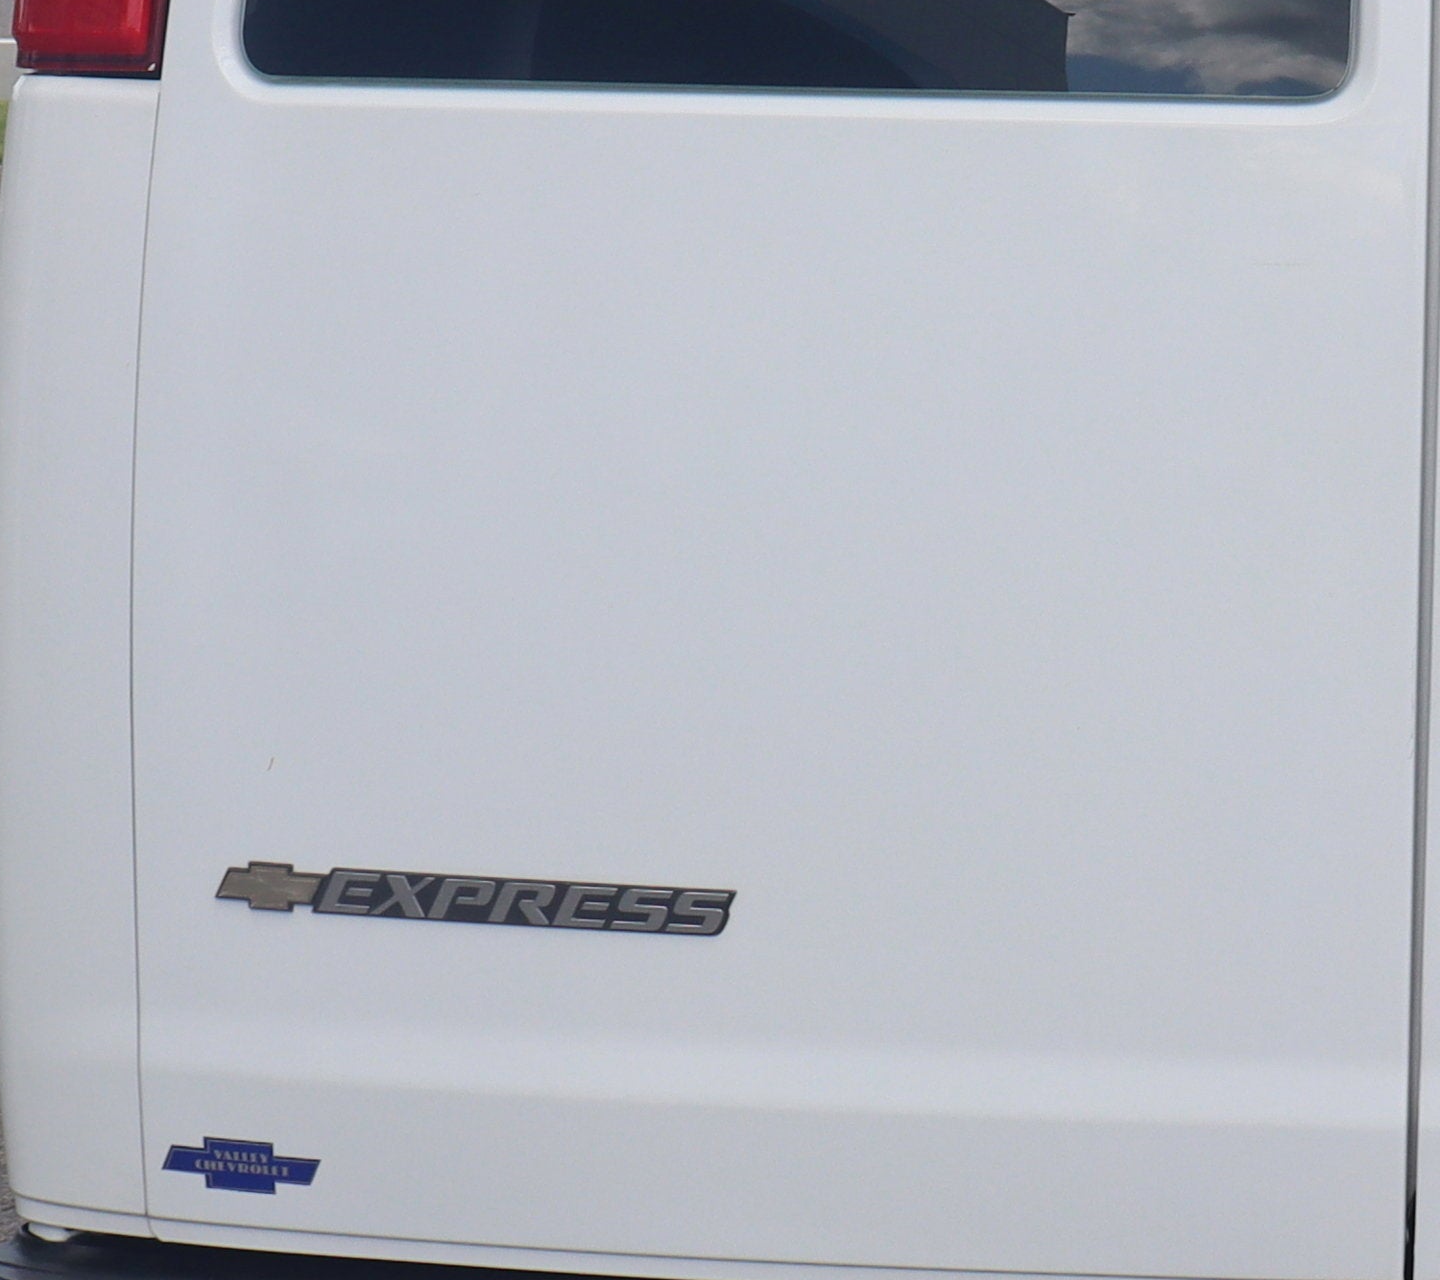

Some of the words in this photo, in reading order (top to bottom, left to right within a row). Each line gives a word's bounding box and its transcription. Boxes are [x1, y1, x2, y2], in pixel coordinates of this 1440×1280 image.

[317, 870, 732, 934] EXPRESS
[213, 1148, 270, 1164] VALLEY
[194, 1158, 290, 1177] CHEVROLET
